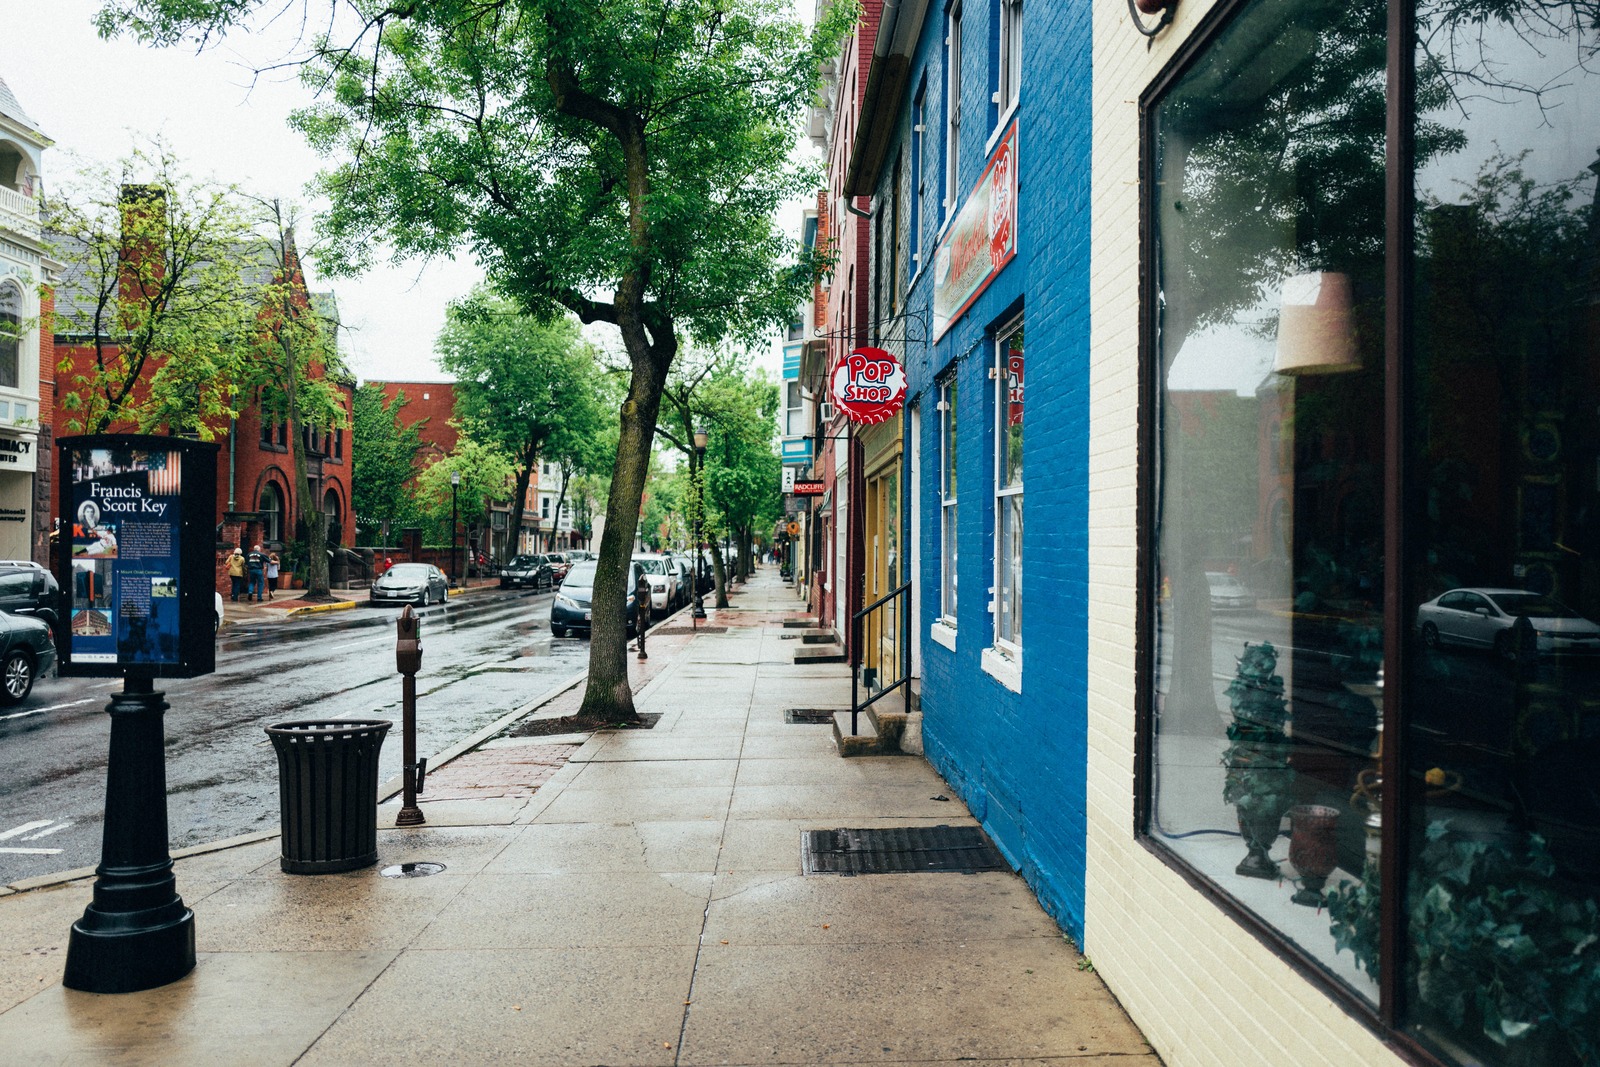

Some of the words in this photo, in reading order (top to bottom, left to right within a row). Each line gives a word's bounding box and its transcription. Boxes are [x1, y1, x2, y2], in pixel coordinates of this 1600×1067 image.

[848, 355, 893, 383] POP
[846, 385, 890, 401] SHOP
[91, 482, 142, 498] Francis
[103, 498, 137, 512] Scott
[141, 498, 167, 517] Key
